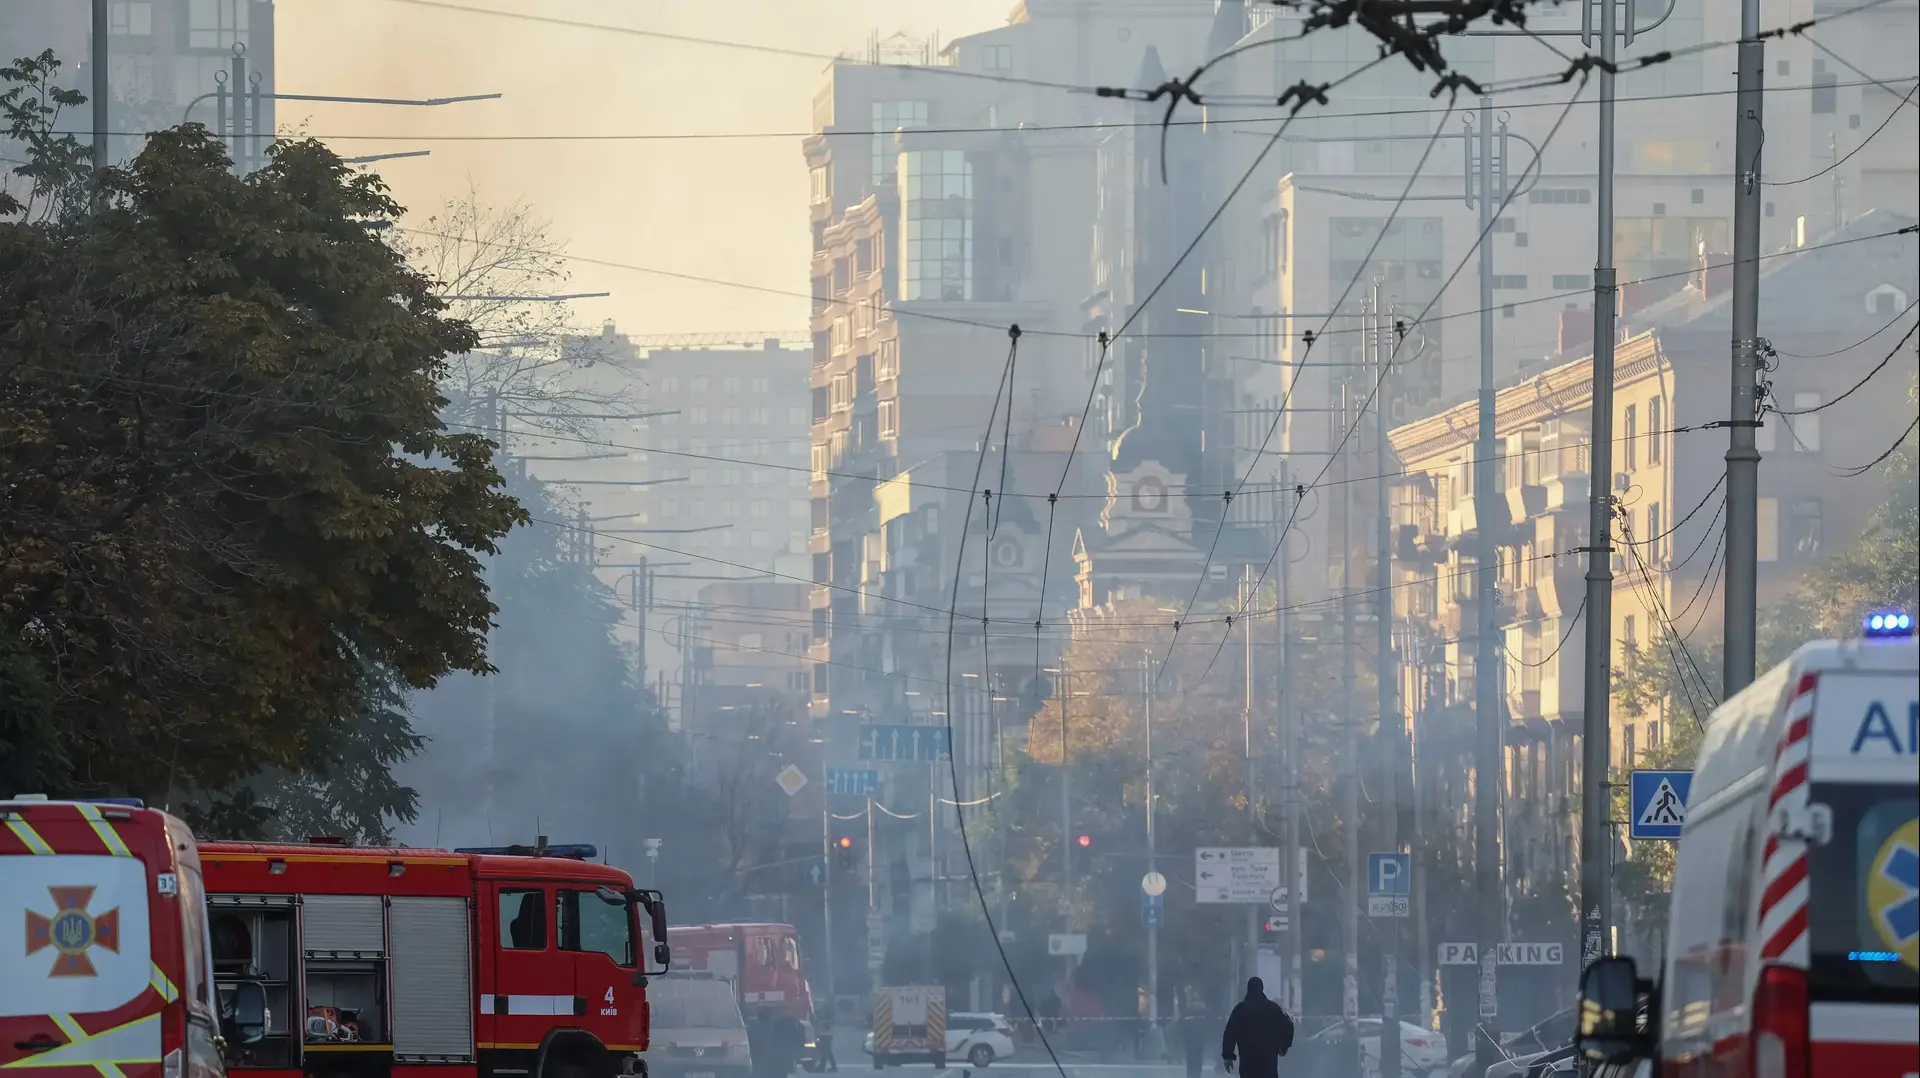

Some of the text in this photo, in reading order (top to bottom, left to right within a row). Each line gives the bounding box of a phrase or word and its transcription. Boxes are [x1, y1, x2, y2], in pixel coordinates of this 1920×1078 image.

[1379, 859, 1402, 890] P
[1446, 945, 1561, 962] PAKING
[604, 986, 615, 1004] 4
[600, 1006, 618, 1016] КИЇВ
